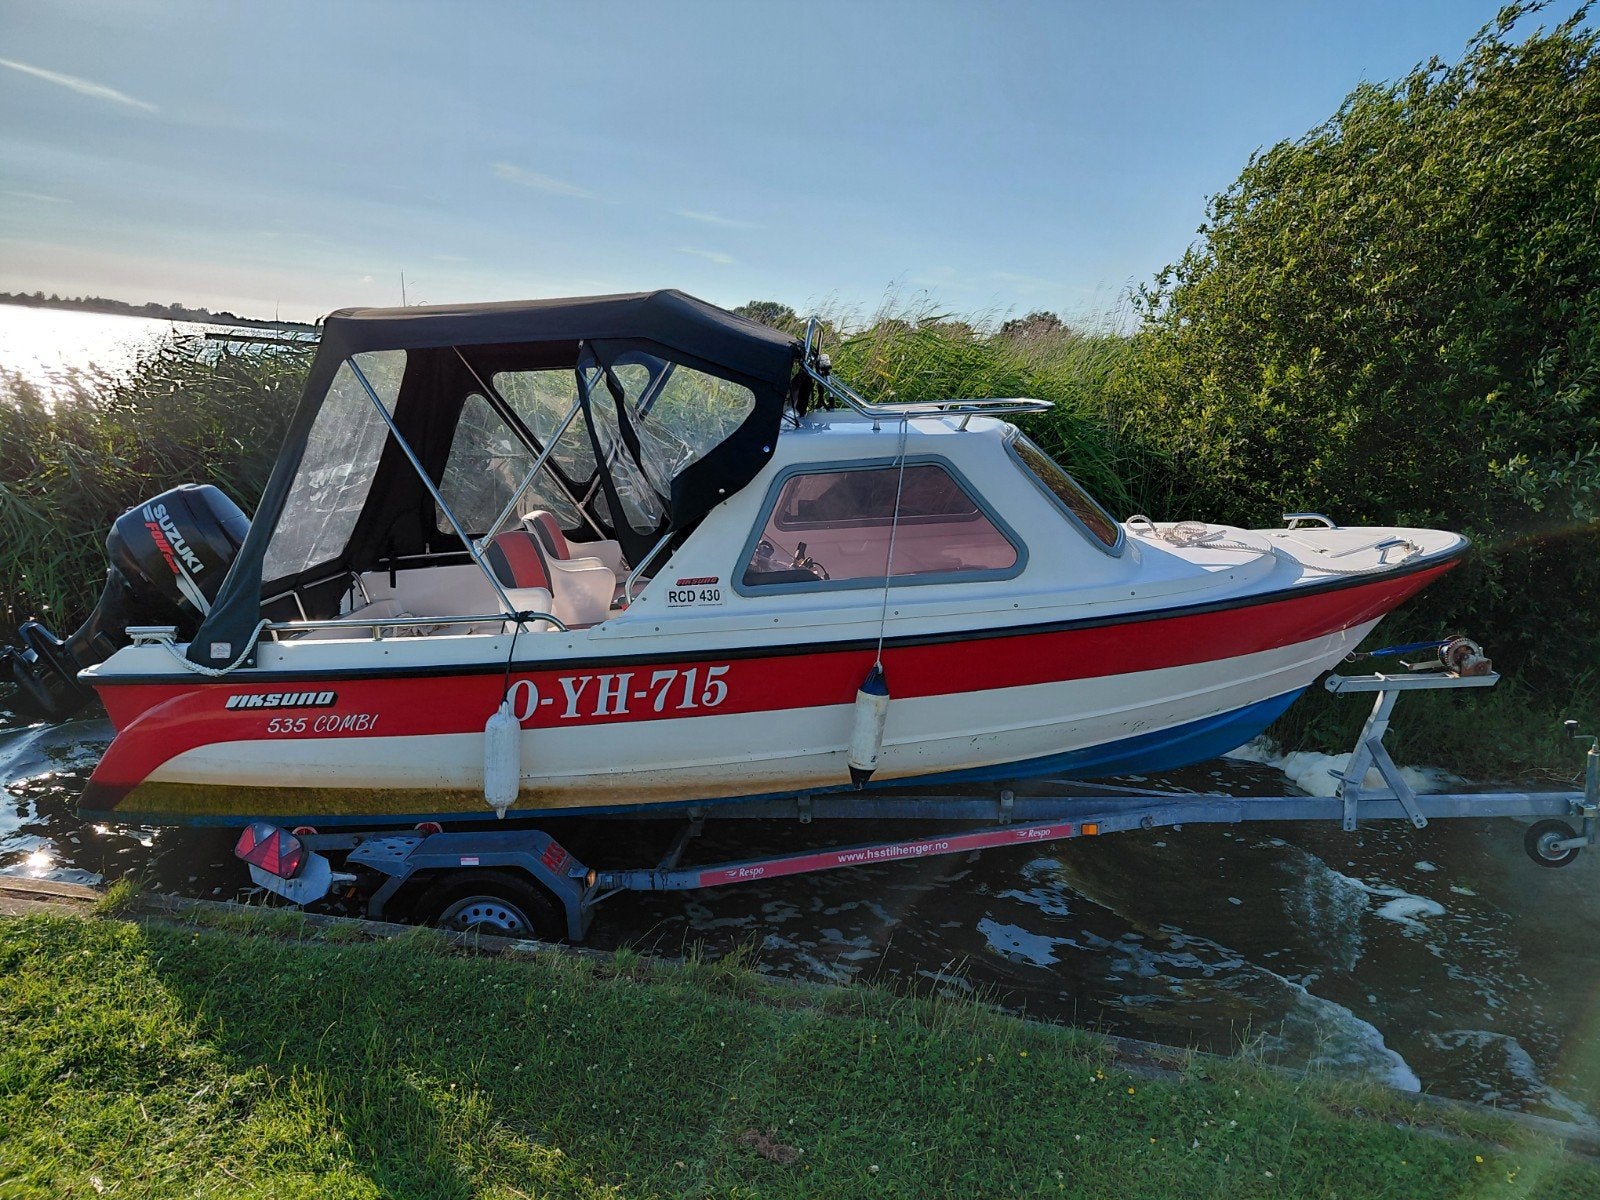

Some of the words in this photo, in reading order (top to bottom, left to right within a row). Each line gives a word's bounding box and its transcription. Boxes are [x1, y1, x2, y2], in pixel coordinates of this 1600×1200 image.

[153, 503, 205, 574] SUZUKI
[668, 590, 696, 603] RCD
[699, 589, 720, 602] 430
[225, 691, 338, 709] VIKSUND
[267, 717, 309, 733] 535
[313, 714, 379, 732] COMBI
[1028, 829, 1051, 839] Respo
[837, 841, 948, 863] www.hsstilhenger.no
[739, 867, 765, 878] Respo
